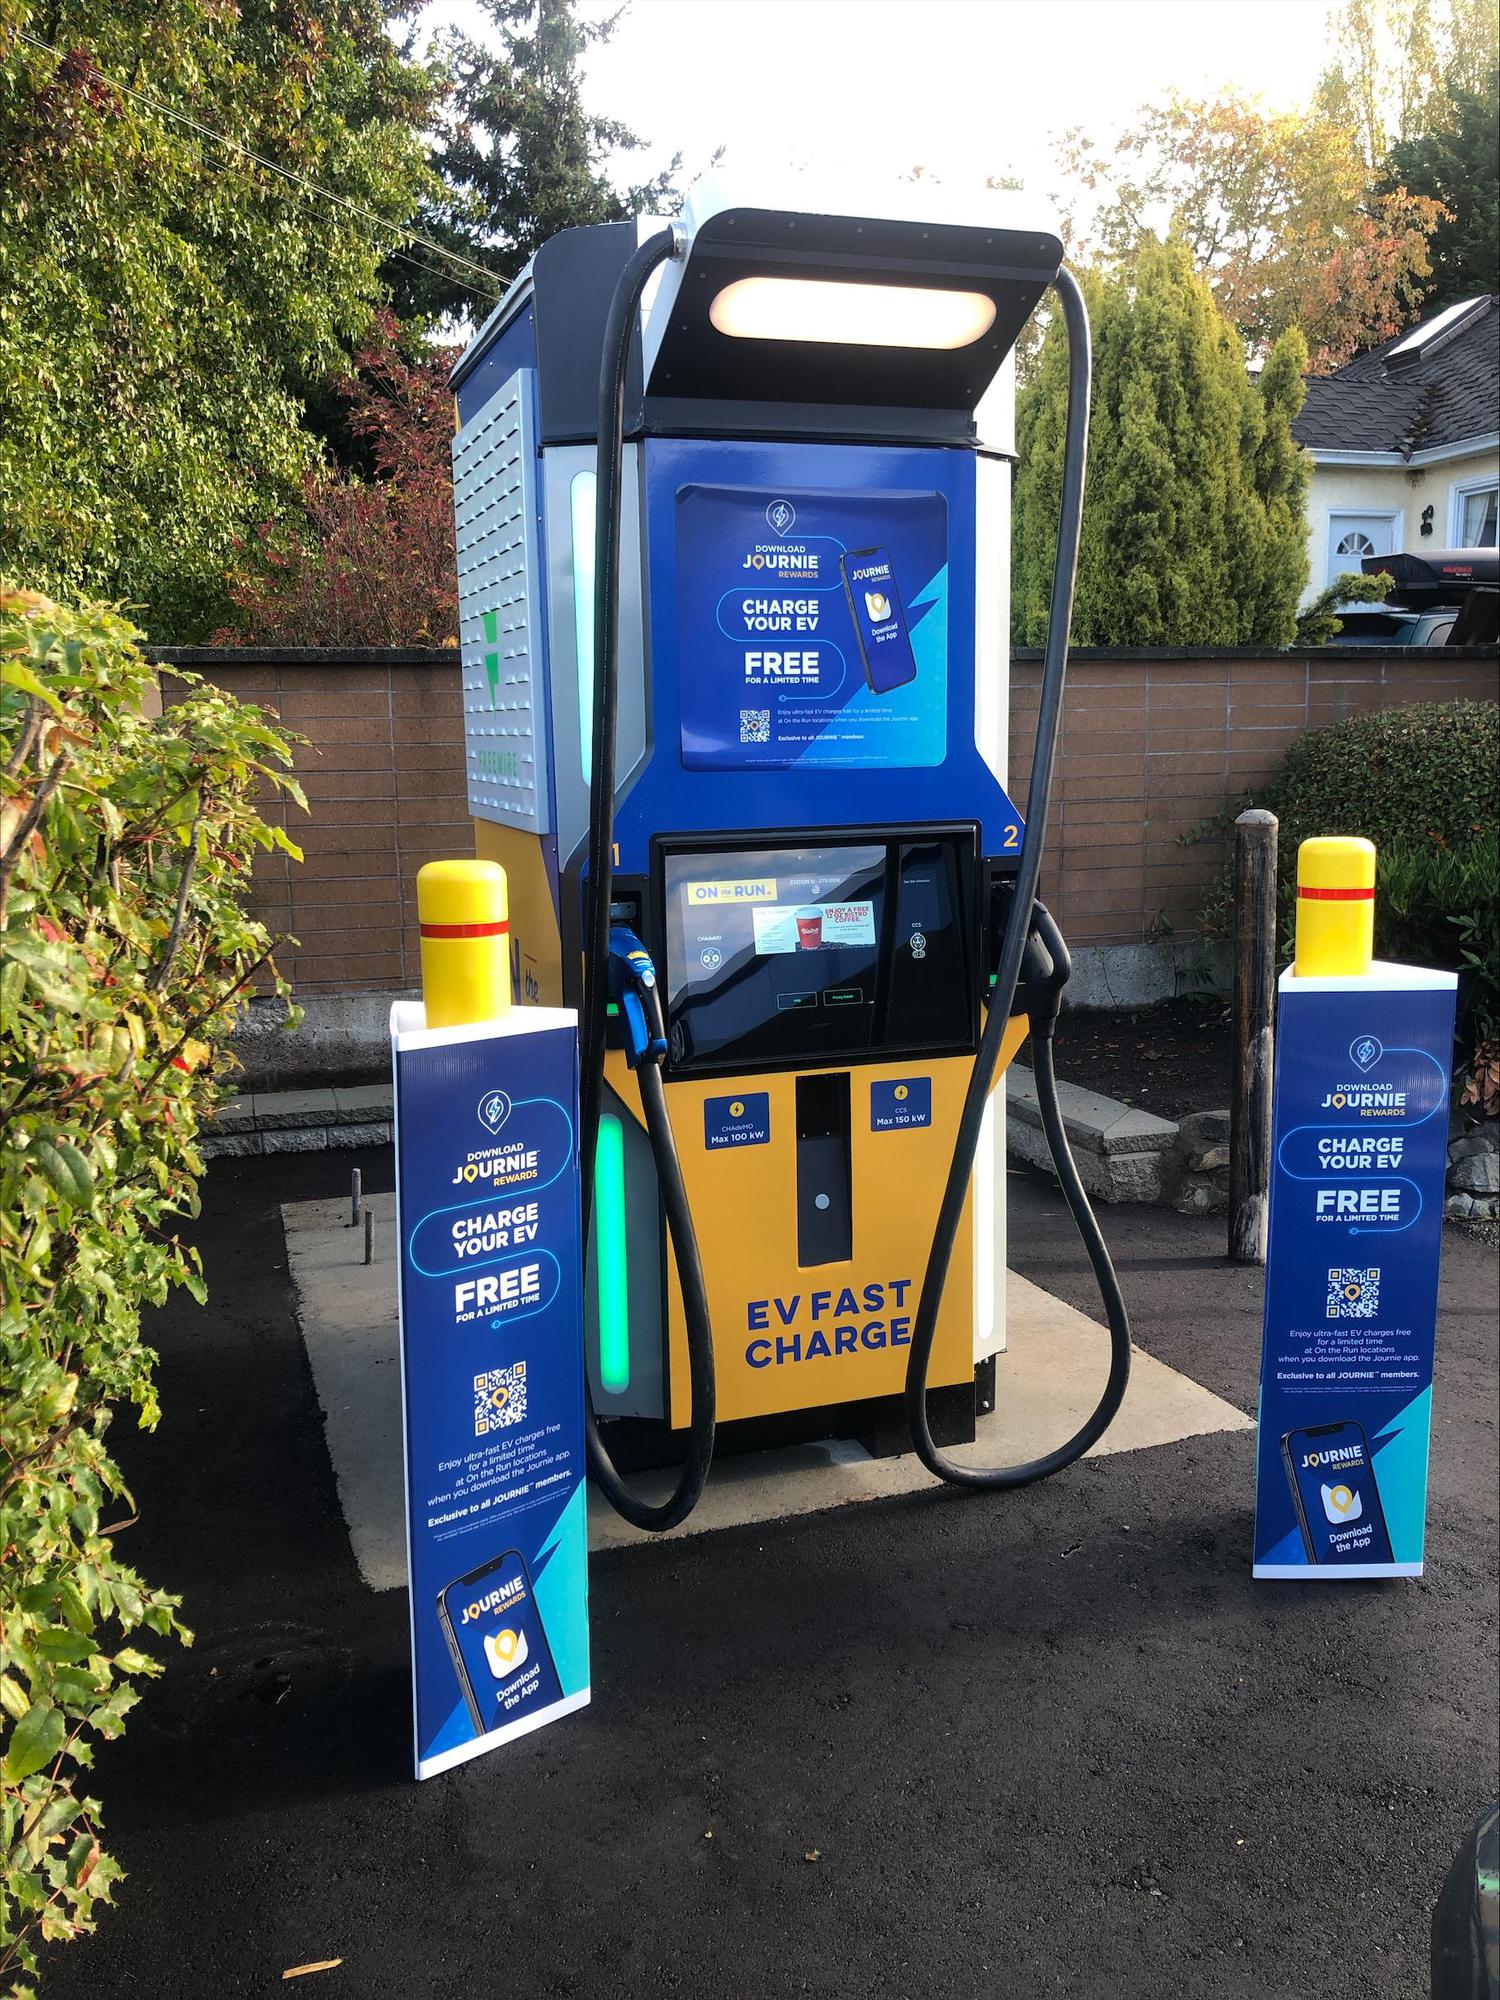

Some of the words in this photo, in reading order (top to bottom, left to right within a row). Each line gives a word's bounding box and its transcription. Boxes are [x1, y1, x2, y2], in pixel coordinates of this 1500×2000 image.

[756, 545, 805, 553] DOWNLOAD
[853, 565, 889, 580] JOURNIE
[743, 600, 818, 614] CHARGE
[744, 617, 791, 630] YOUR
[796, 617, 818, 630] EV
[872, 622, 898, 636] Download
[745, 652, 819, 675] FREE
[1003, 825, 1018, 847] 2
[612, 843, 620, 867] 1
[696, 888, 717, 898] ON
[526, 969, 539, 1003] the
[721, 1123, 753, 1133] CHAdeMO
[876, 1117, 893, 1125] Max
[896, 1115, 909, 1123] 150
[911, 1114, 925, 1122] kW
[711, 1135, 729, 1144] Max
[731, 1133, 747, 1141] 100
[750, 1130, 764, 1140] kW
[1318, 1138, 1403, 1153] CHARGE
[467, 1143, 523, 1162] DOWNLOAD
[1319, 1156, 1372, 1169] YOUR
[1377, 1155, 1402, 1168] EV
[493, 1170, 538, 1187] REWARDS
[1317, 1189, 1400, 1213] FREE
[452, 1203, 538, 1239] CHARGE
[453, 1231, 509, 1258] YOUR
[514, 1223, 538, 1243] EV
[455, 1264, 539, 1313] FREE
[456, 1312, 474, 1323] FOR
[477, 1308, 483, 1318] A
[485, 1299, 518, 1316] LIMITED
[521, 1293, 539, 1307] TIME
[747, 1295, 800, 1330] EV
[811, 1279, 911, 1321] FAST
[746, 1317, 911, 1368] CHARGE
[1290, 1330, 1311, 1339] Enjoy
[438, 1458, 462, 1471] Enjoy
[464, 1446, 500, 1463] ultra-fast
[502, 1440, 514, 1450] EV
[515, 1430, 544, 1445] charges
[547, 1424, 560, 1434] free
[469, 1462, 480, 1472] for
[489, 1450, 516, 1465] limited
[518, 1443, 535, 1454] time
[466, 1474, 478, 1483] On
[481, 1468, 494, 1480] the
[496, 1461, 511, 1473] Run
[513, 1449, 547, 1466] locations
[1332, 1459, 1364, 1470] REWARDS
[428, 1493, 451, 1506] when
[453, 1488, 468, 1498] you
[471, 1474, 510, 1492] download
[512, 1468, 524, 1480] the
[527, 1456, 553, 1472] Journie
[428, 1508, 468, 1527] Exclusive
[470, 1503, 479, 1513] to
[481, 1498, 491, 1509] all
[1329, 1524, 1372, 1543] Download
[1336, 1541, 1350, 1552] the
[1353, 1537, 1370, 1550] App
[493, 1591, 526, 1616] REWARDS
[496, 1663, 540, 1702] Download
[504, 1695, 520, 1710] the
[522, 1679, 539, 1701] App
